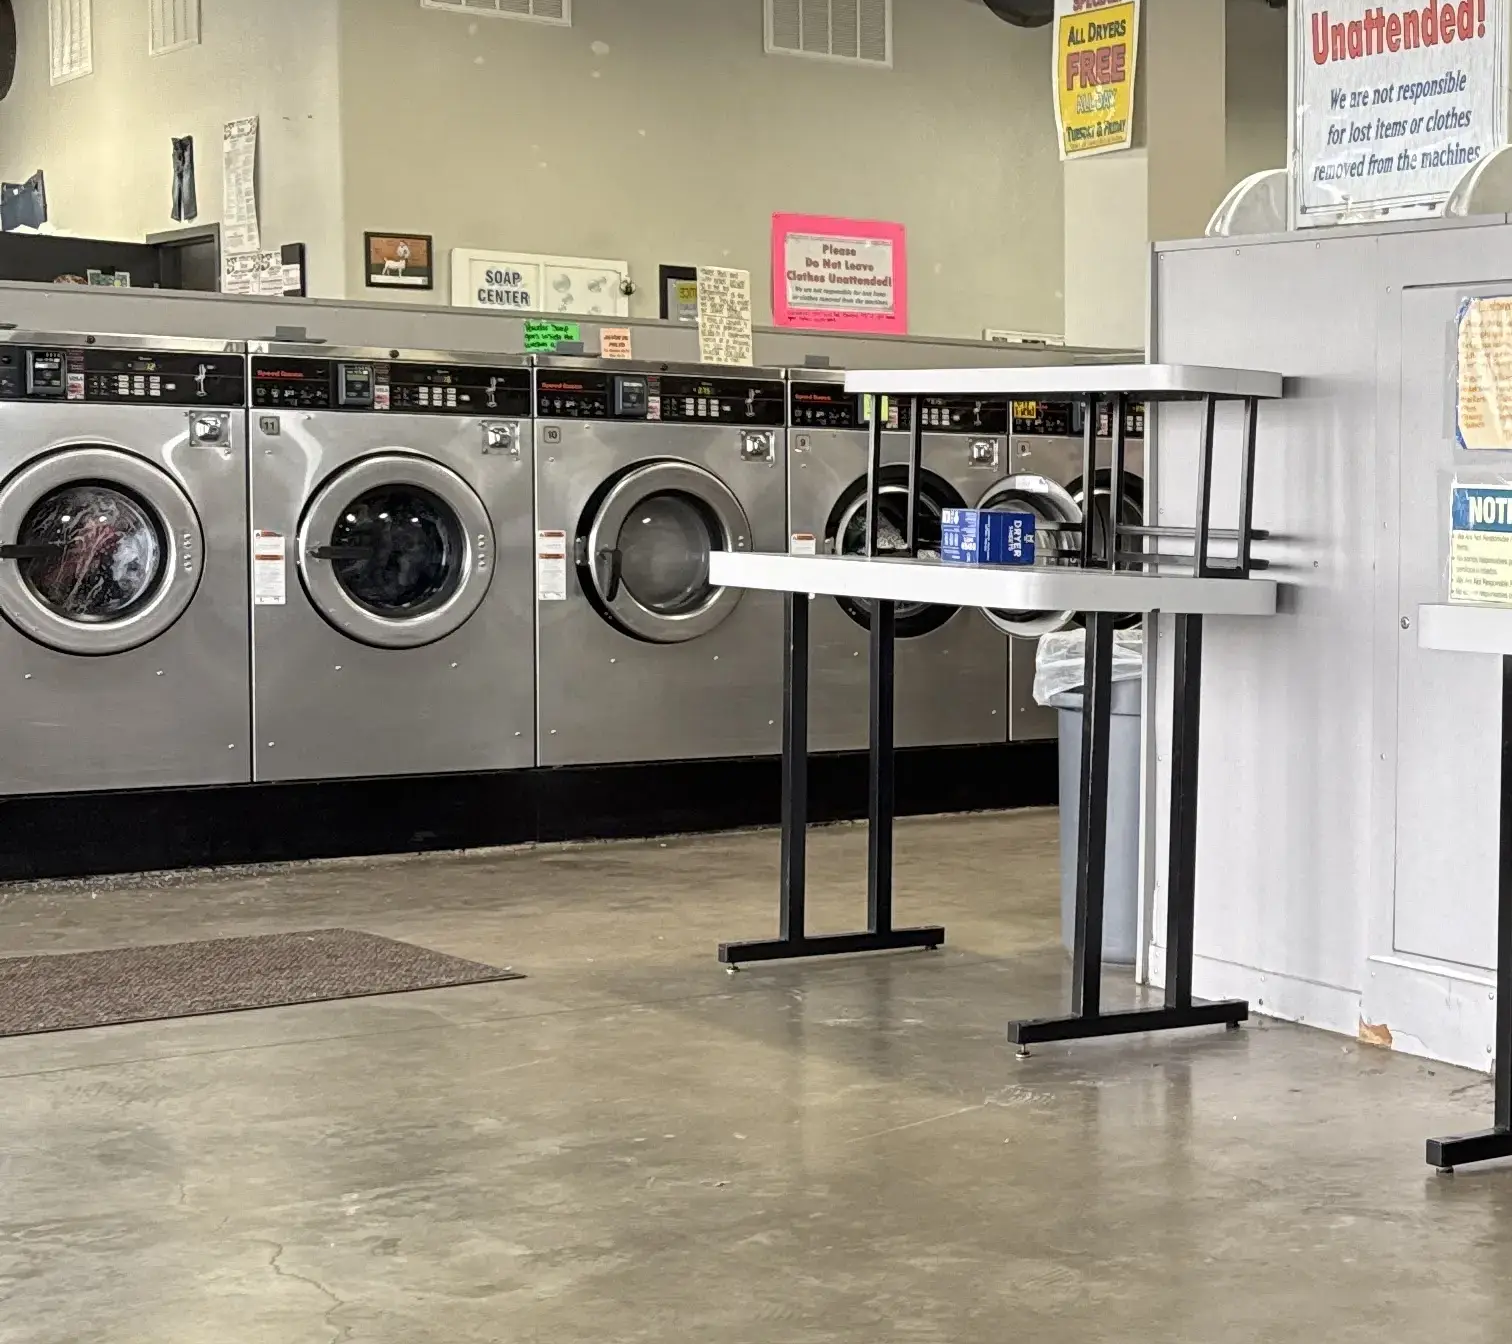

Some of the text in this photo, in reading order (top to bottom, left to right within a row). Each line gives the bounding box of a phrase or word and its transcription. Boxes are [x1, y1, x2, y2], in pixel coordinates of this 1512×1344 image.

[1067, 19, 1126, 47] ALL DRYERS
[1066, 43, 1126, 91] FREE
[1330, 70, 1467, 111] We are not responsible
[1327, 108, 1472, 147] for lost items or clothes
[1312, 141, 1481, 182] removed from the machines
[822, 244, 857, 257] Please
[805, 257, 874, 272] Do Not Leave
[485, 269, 522, 286] SOAP
[787, 270, 892, 287] Clothes Unattended!
[477, 288, 530, 306] CENTER
[264, 421, 275, 431] 11
[548, 430, 557, 440] 10
[1013, 519, 1023, 558] DRYER
